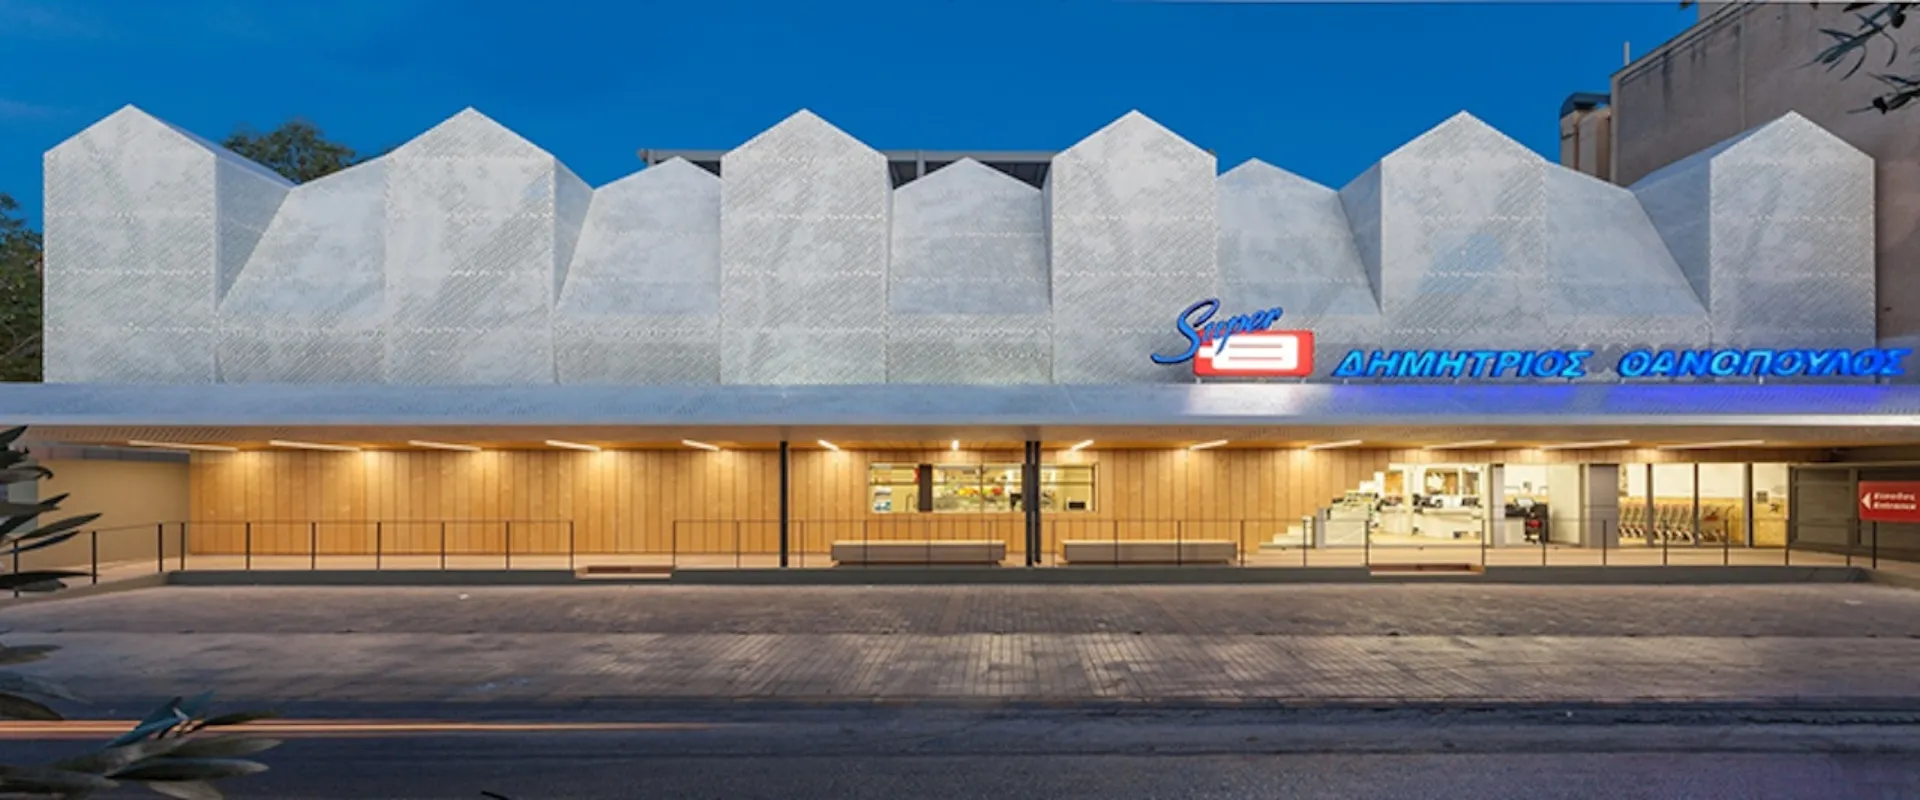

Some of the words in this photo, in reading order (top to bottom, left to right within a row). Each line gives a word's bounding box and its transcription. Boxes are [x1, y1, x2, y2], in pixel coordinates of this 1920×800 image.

[1151, 298, 1283, 364] Super
[1332, 349, 1594, 378] ΔΗΜΗΤΡΙΟΣ
[1617, 347, 1913, 377] ΘΑΝΟΠΟΥΛΟΣ
